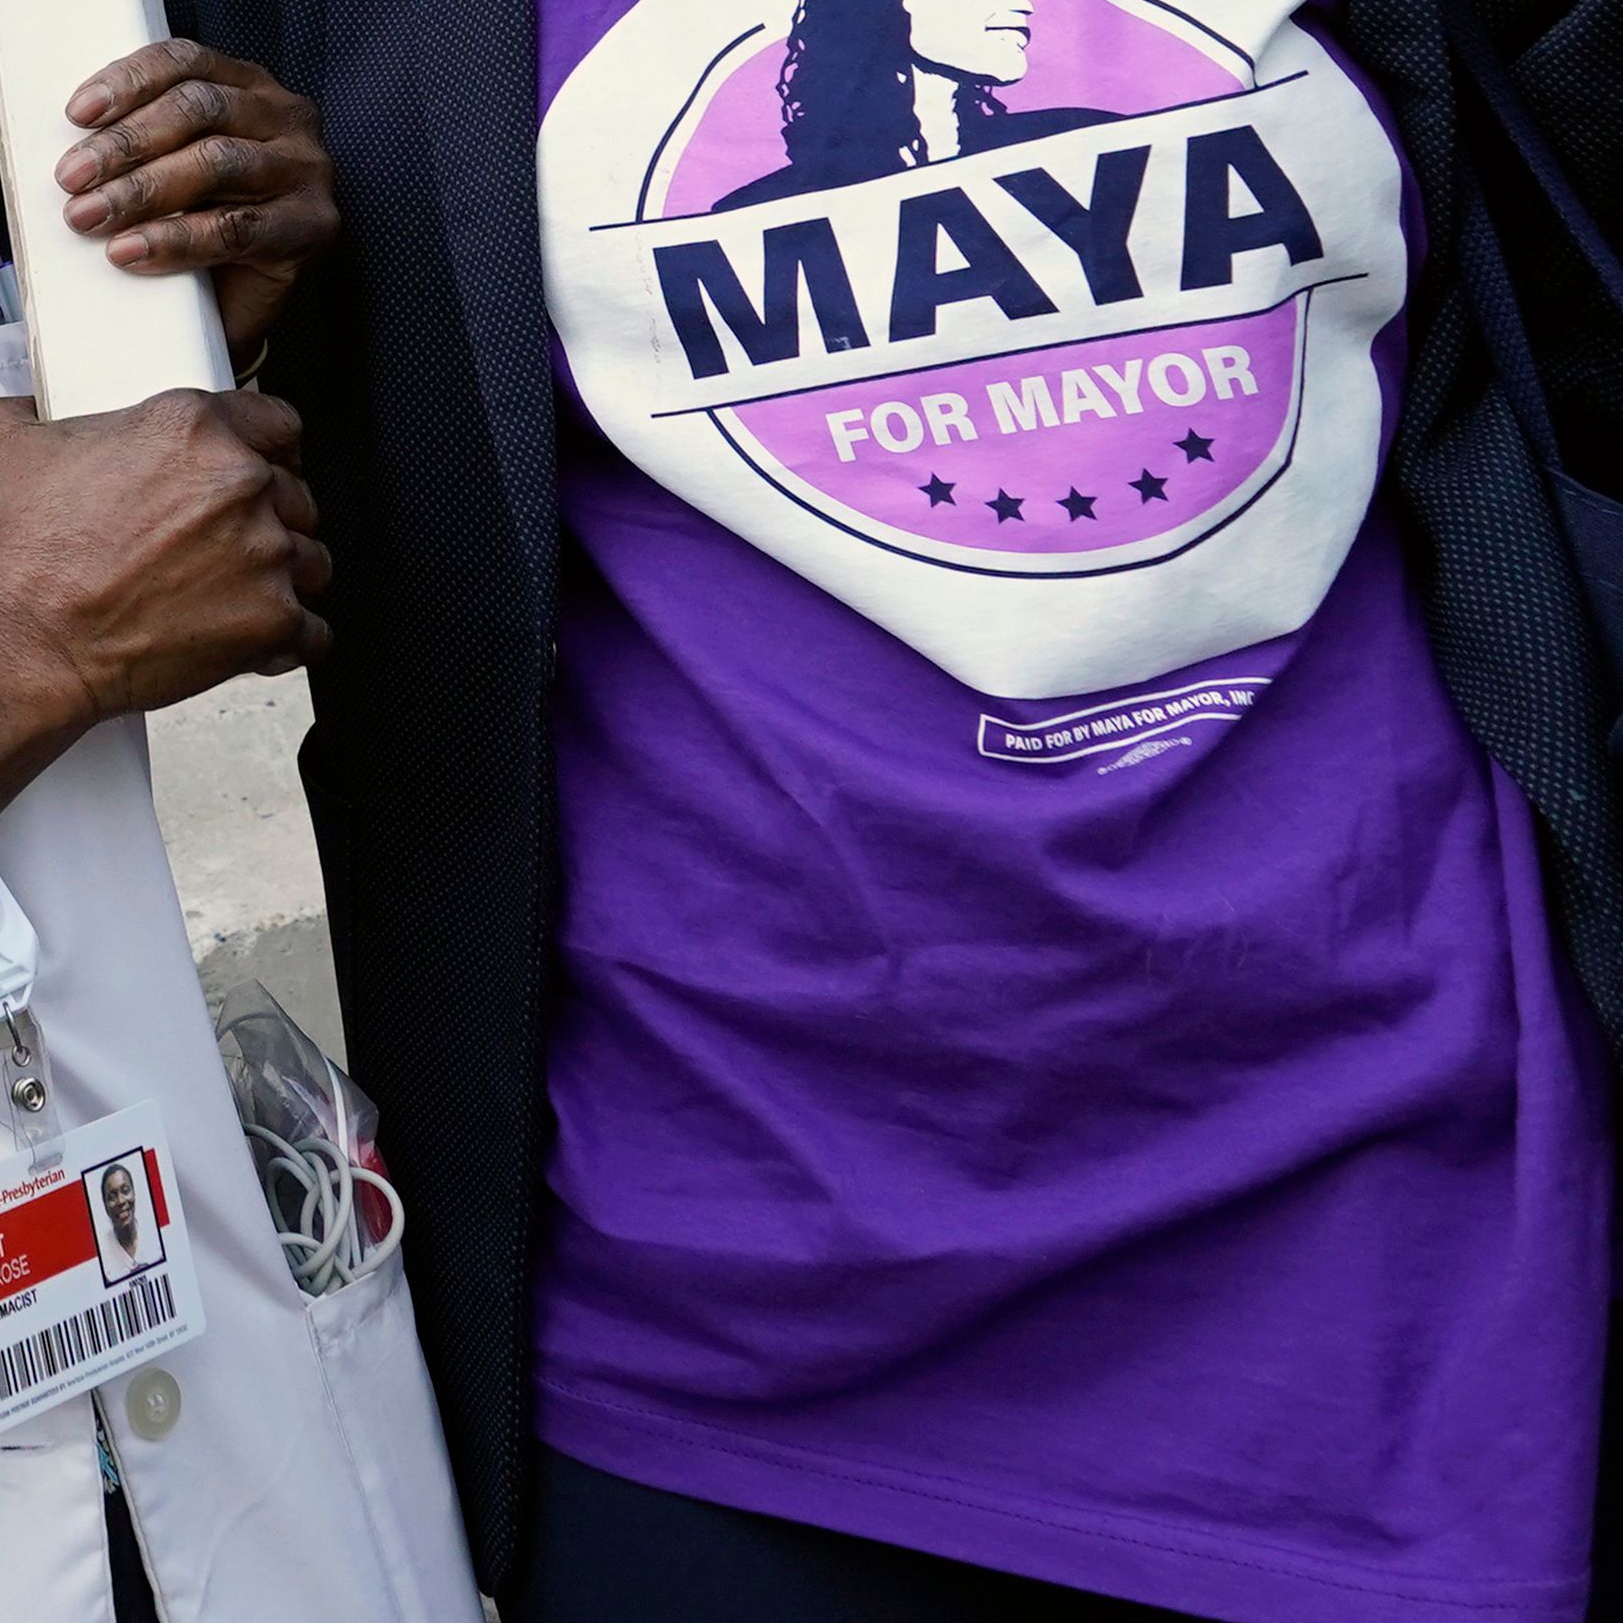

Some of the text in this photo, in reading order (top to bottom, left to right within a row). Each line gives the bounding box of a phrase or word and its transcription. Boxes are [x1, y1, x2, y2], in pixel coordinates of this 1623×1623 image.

[651, 124, 1325, 380] MAYA
[825, 344, 1259, 463] FOR MAYOR
[1005, 733, 1042, 750] PAID
[1046, 731, 1073, 749] FOR
[1074, 725, 1091, 743] BY
[1092, 714, 1132, 737] MAYA
[1133, 706, 1167, 727] FOR
[1167, 690, 1231, 717] MAYOR,
